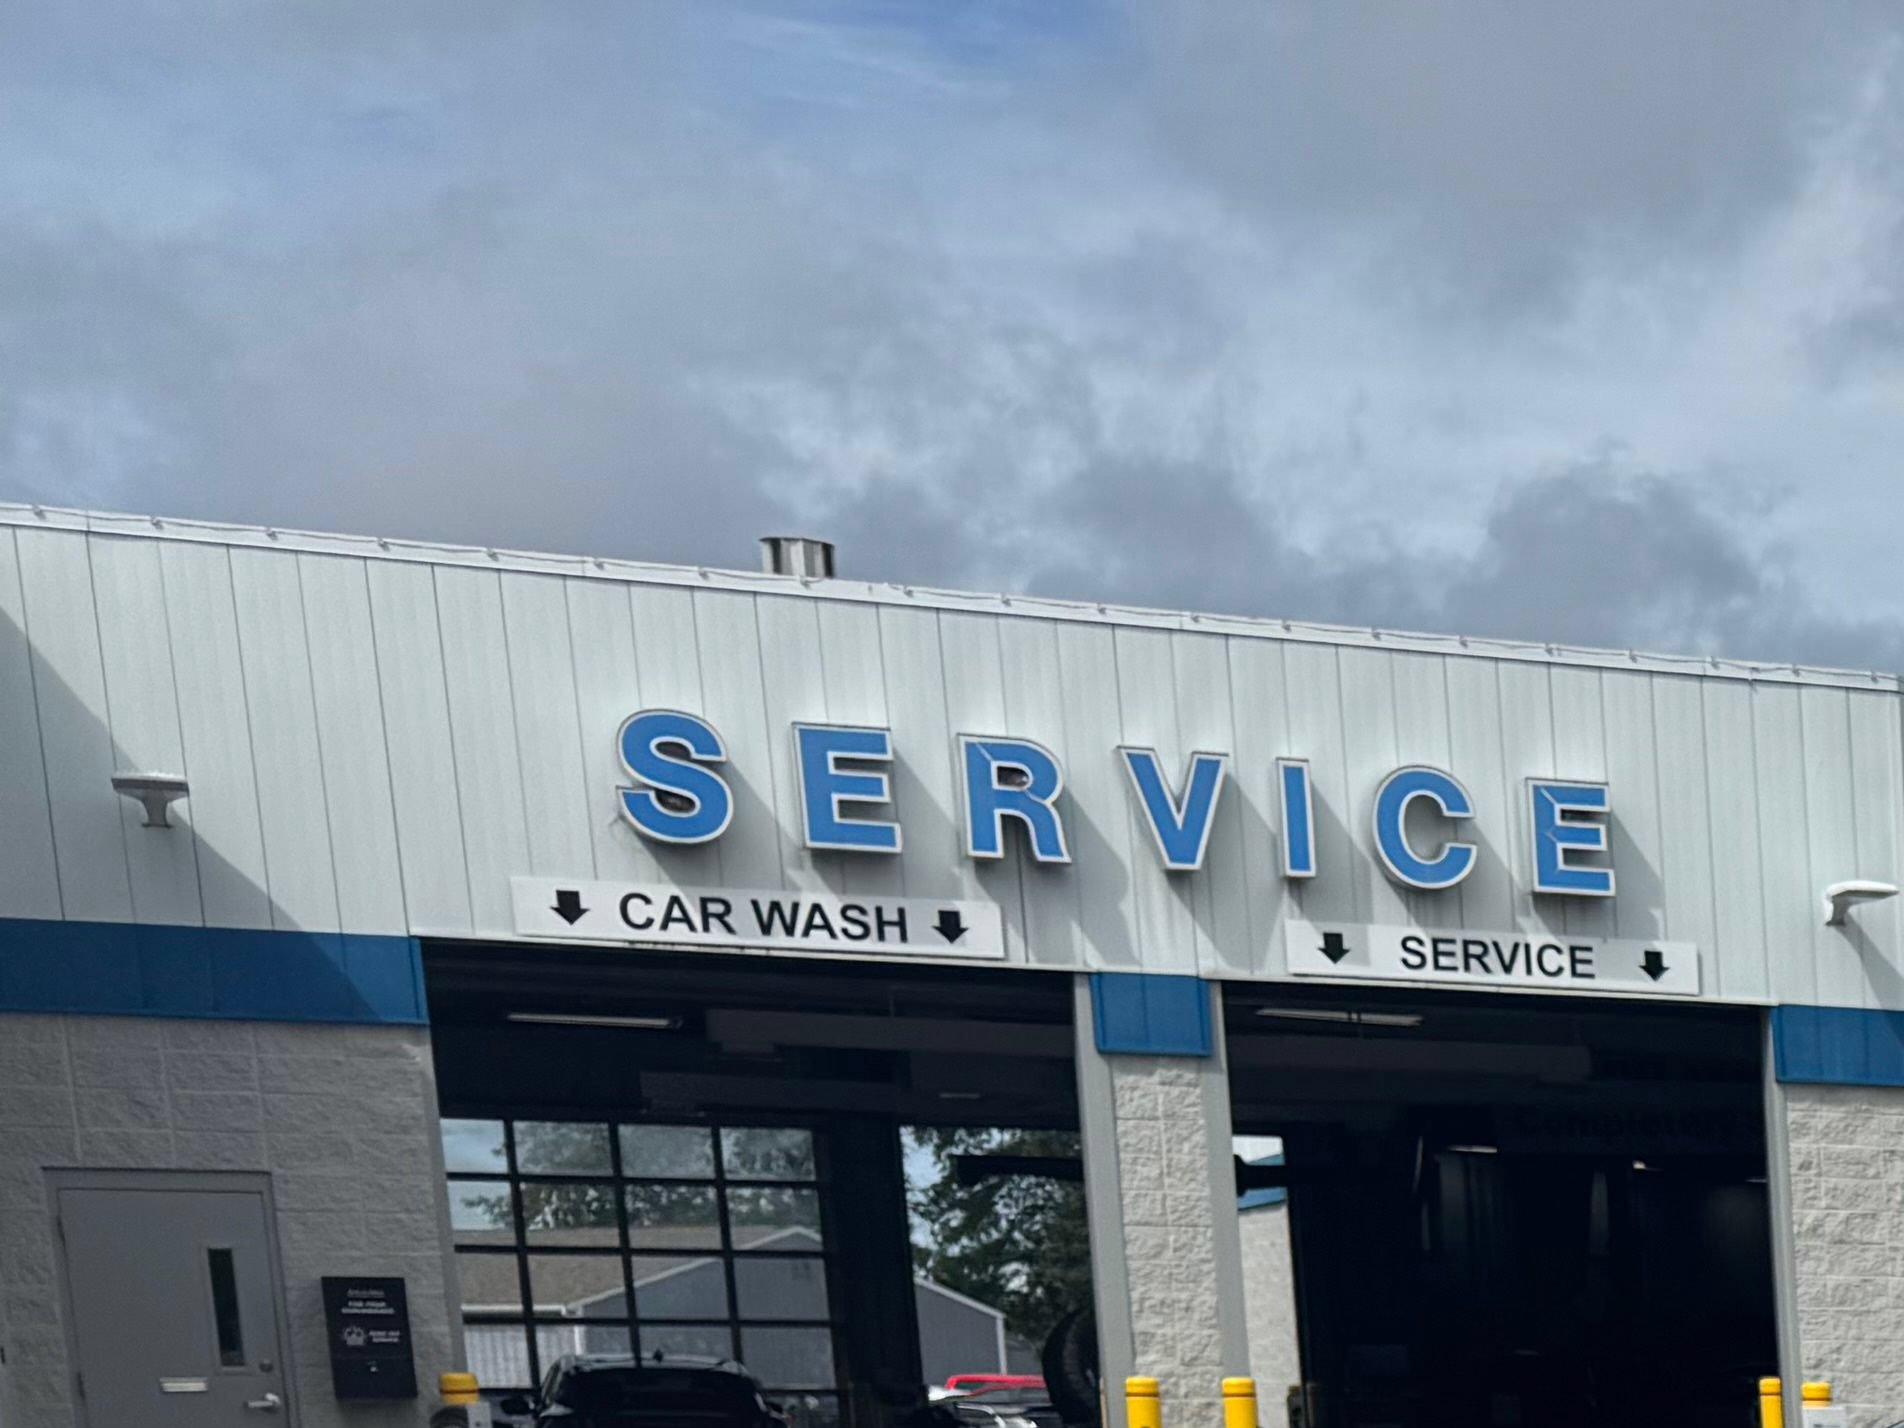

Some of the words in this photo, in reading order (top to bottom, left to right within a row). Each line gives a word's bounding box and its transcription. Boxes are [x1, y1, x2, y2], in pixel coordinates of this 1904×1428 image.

[616, 709, 1616, 898] SERVICE
[617, 891, 732, 934] CAR
[751, 897, 908, 945] WASH
[1401, 935, 1597, 980] SERVICE
